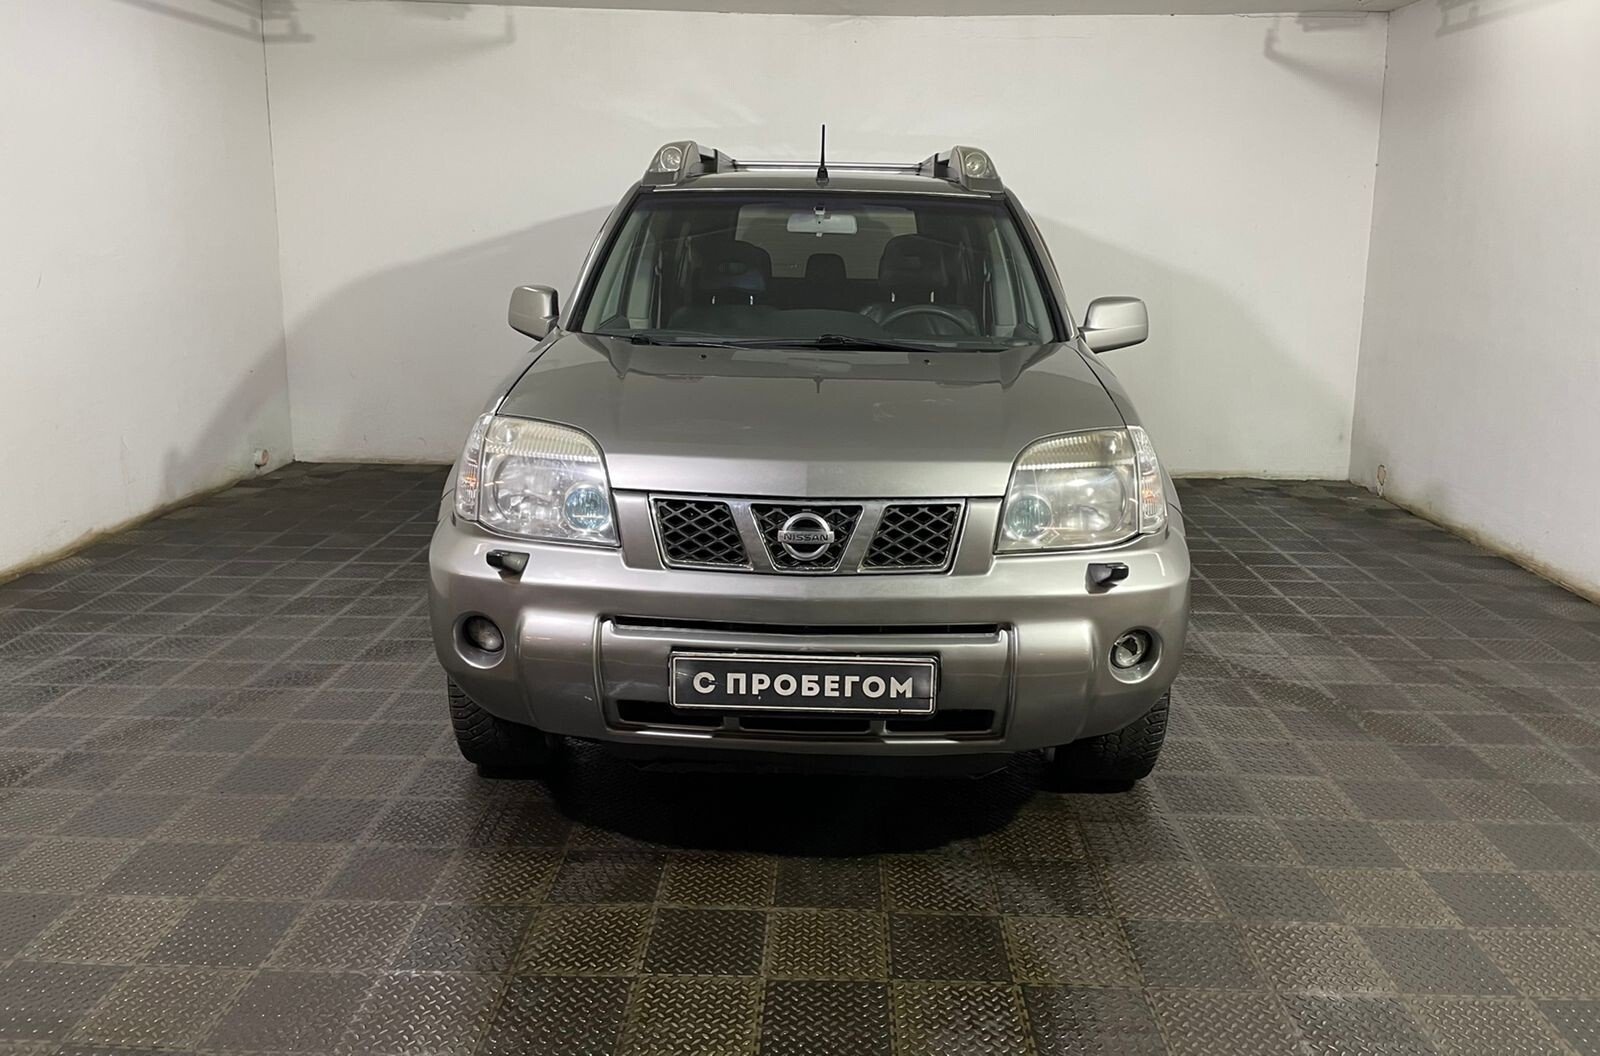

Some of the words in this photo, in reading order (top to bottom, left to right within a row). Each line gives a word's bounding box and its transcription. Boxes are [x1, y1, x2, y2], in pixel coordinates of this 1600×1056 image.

[783, 533, 829, 541] NISSAN
[692, 671, 716, 695] С
[726, 672, 913, 698] ПРОБЕГОМ
